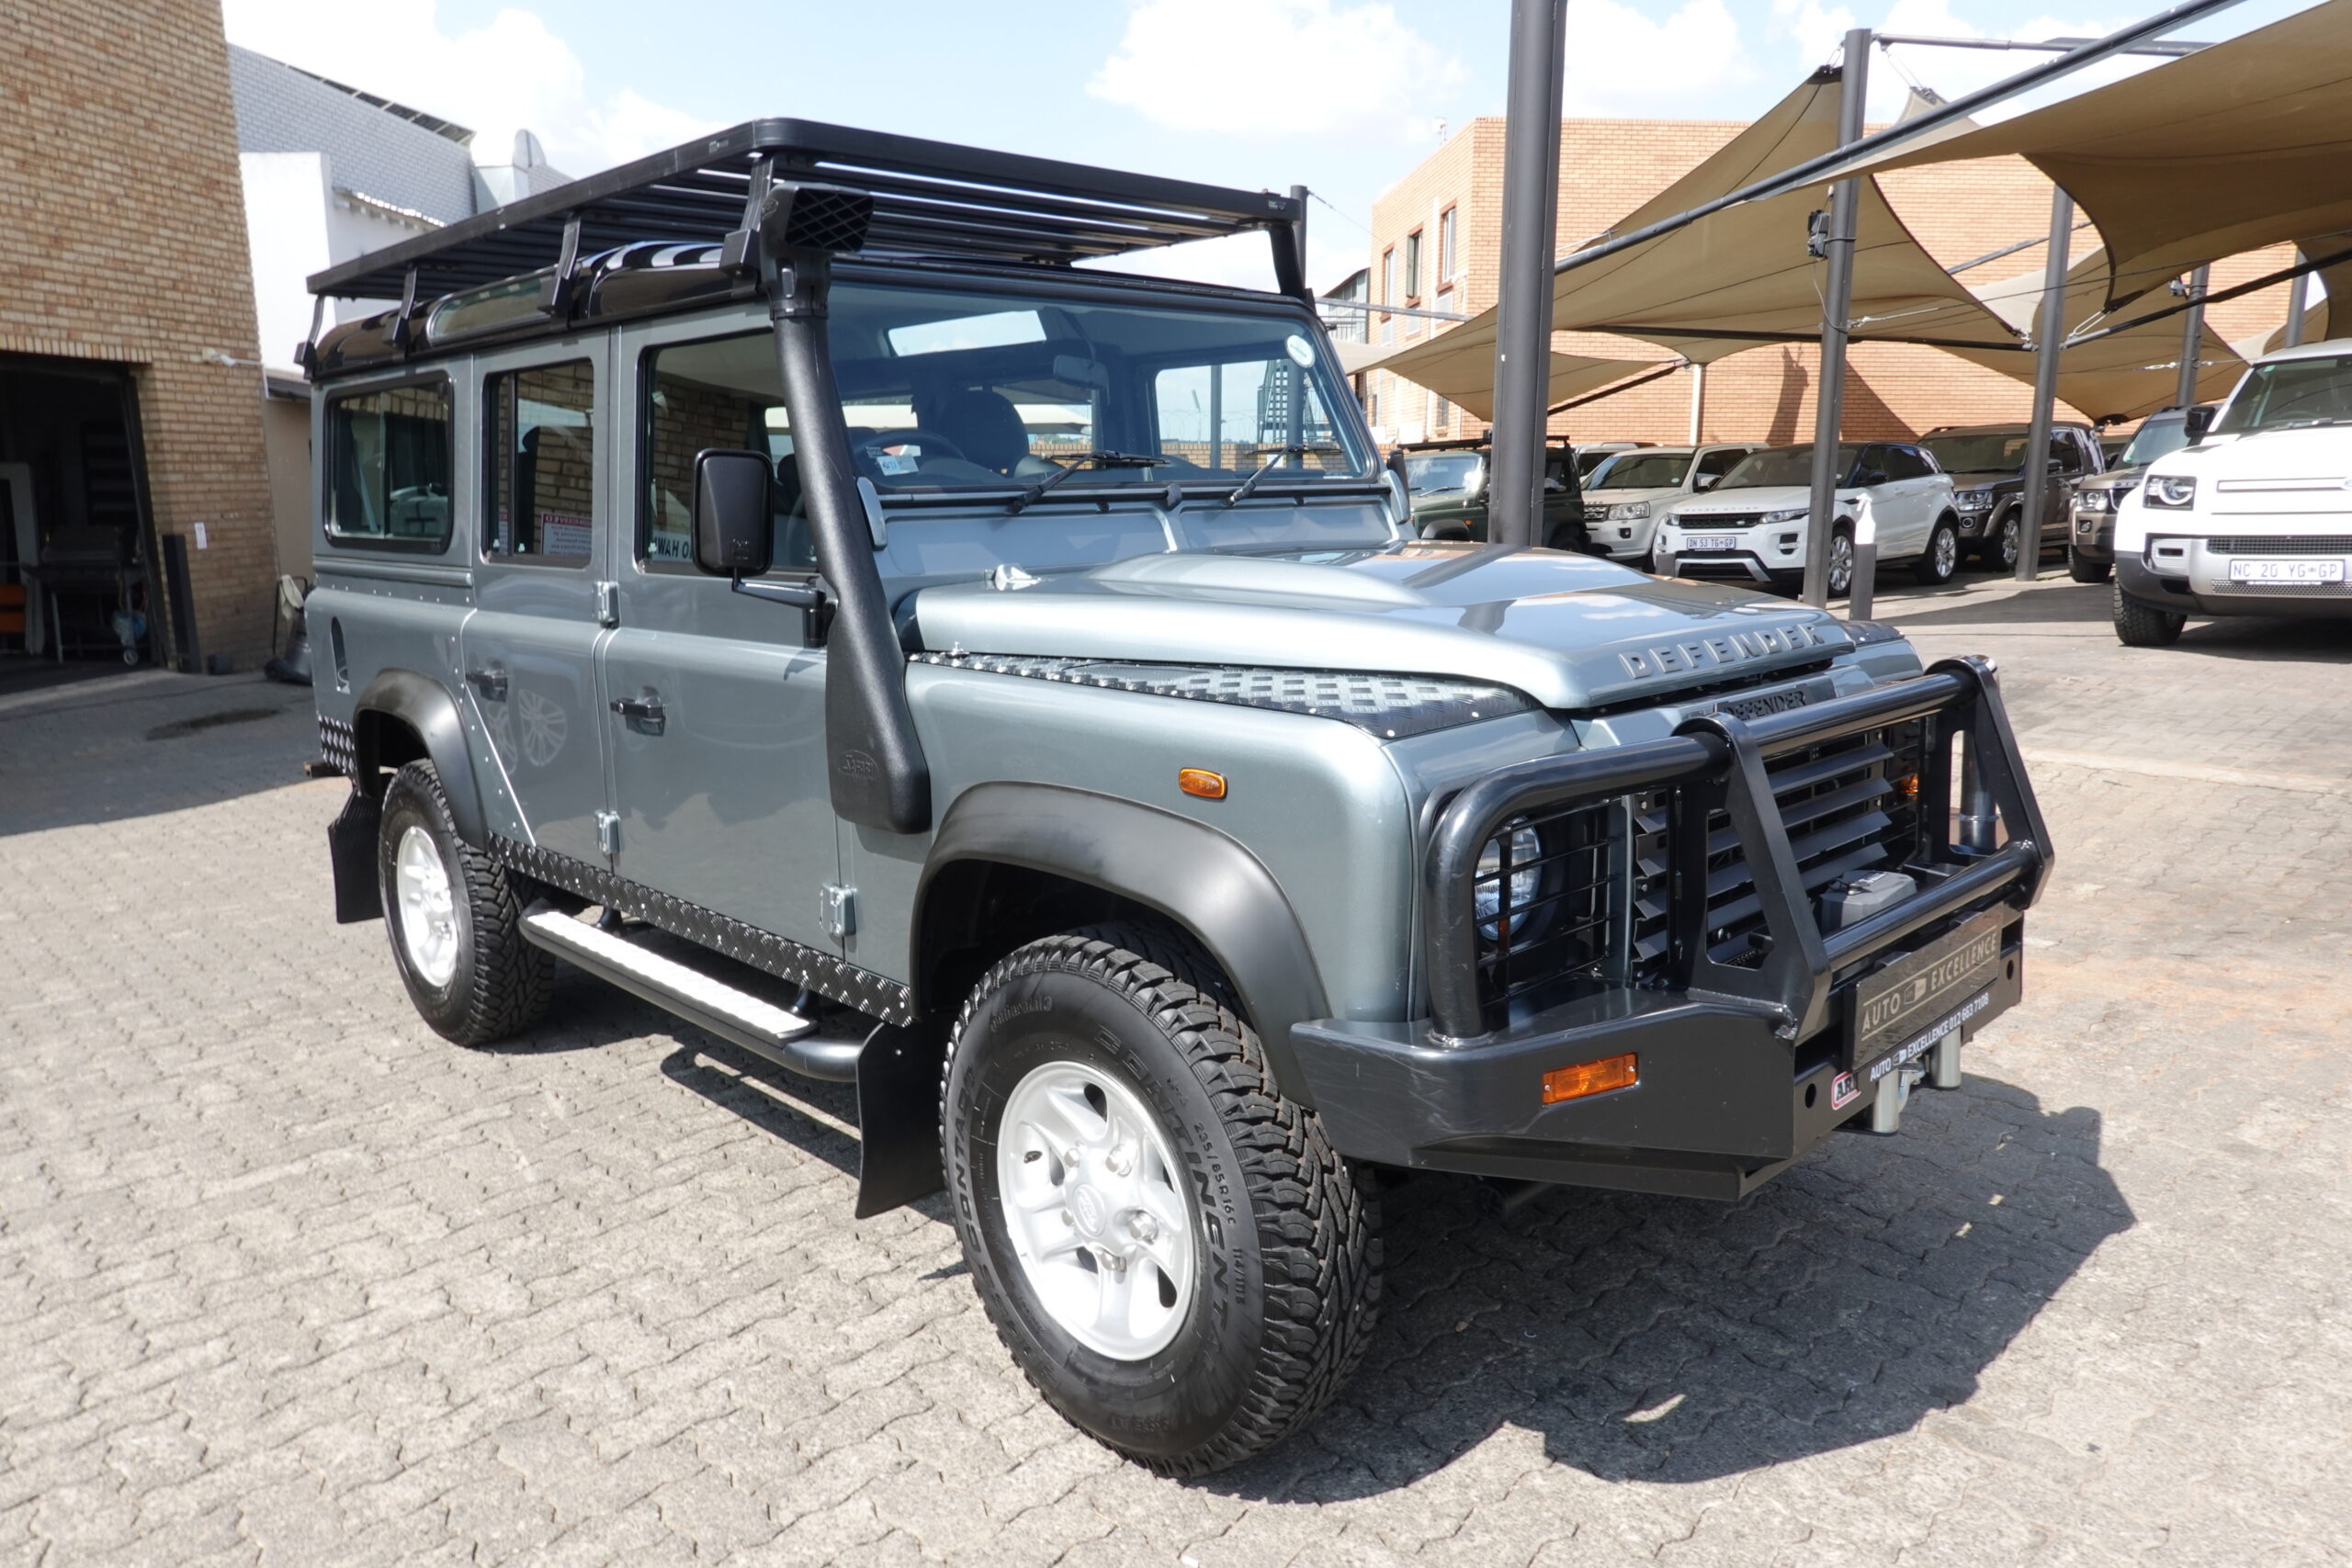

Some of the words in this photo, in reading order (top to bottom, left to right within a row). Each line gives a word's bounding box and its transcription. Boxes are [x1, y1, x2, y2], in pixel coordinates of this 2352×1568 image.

[1689, 538, 1697, 547] DN
[1700, 538, 1708, 547] 53
[1711, 538, 1719, 547] TG
[1724, 538, 1734, 547] GP
[2233, 563, 2251, 578] NC
[2260, 563, 2278, 578] 20
[2288, 563, 2306, 578] YG
[2318, 563, 2337, 578] GP
[1618, 624, 1825, 679] DEFENDER
[1861, 992, 1900, 1033] AUTO
[1931, 932, 1996, 991] EXCELLENCE
[1870, 1057, 1892, 1082] AUTO
[1907, 1020, 1949, 1058] EXCELLENCE
[1949, 1011, 1962, 1030] 012
[1837, 1073, 1856, 1101] AR
